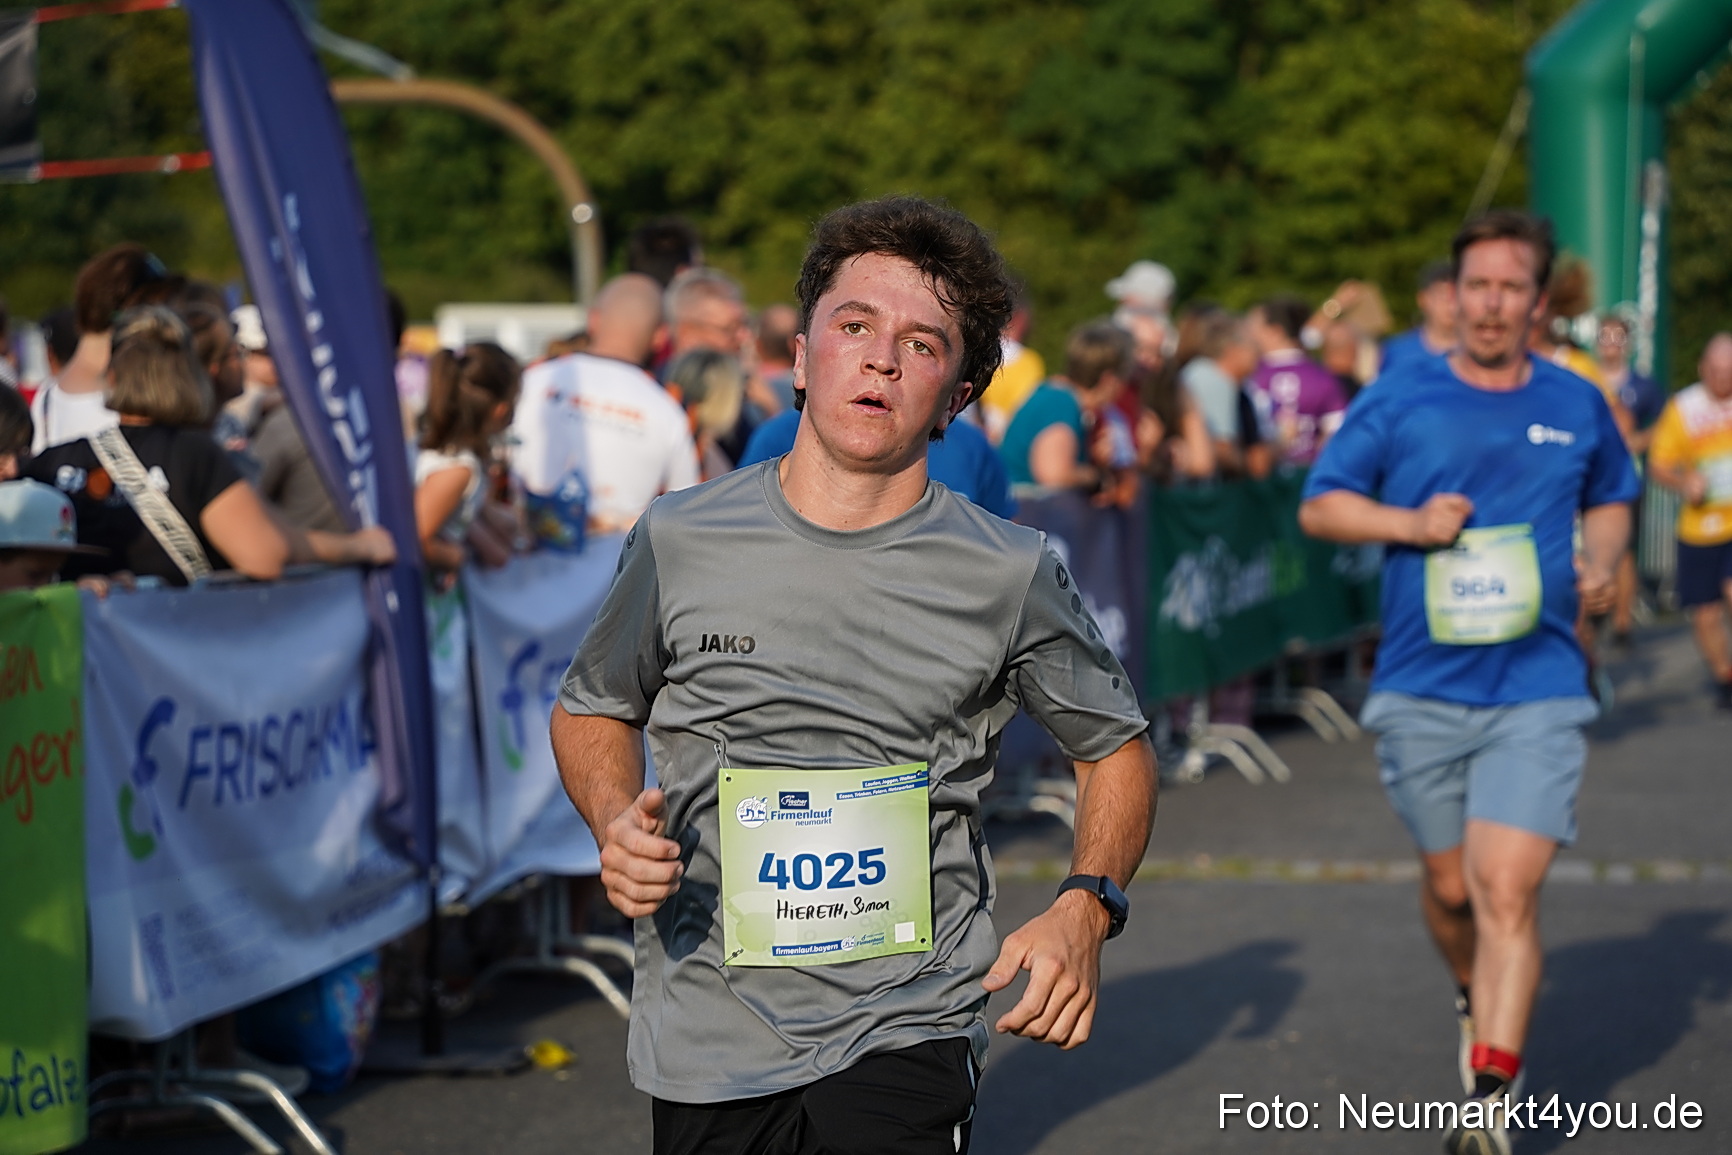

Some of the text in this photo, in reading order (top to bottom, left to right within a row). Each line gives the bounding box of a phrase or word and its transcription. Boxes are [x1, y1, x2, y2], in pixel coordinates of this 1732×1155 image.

[698, 633, 756, 654] JAKO
[770, 808, 833, 820] Firmenlauf
[795, 818, 832, 826] neumarkt
[758, 847, 887, 891] 4025
[850, 896, 890, 915] Simon
[775, 943, 839, 955] firmenlauf.bayern
